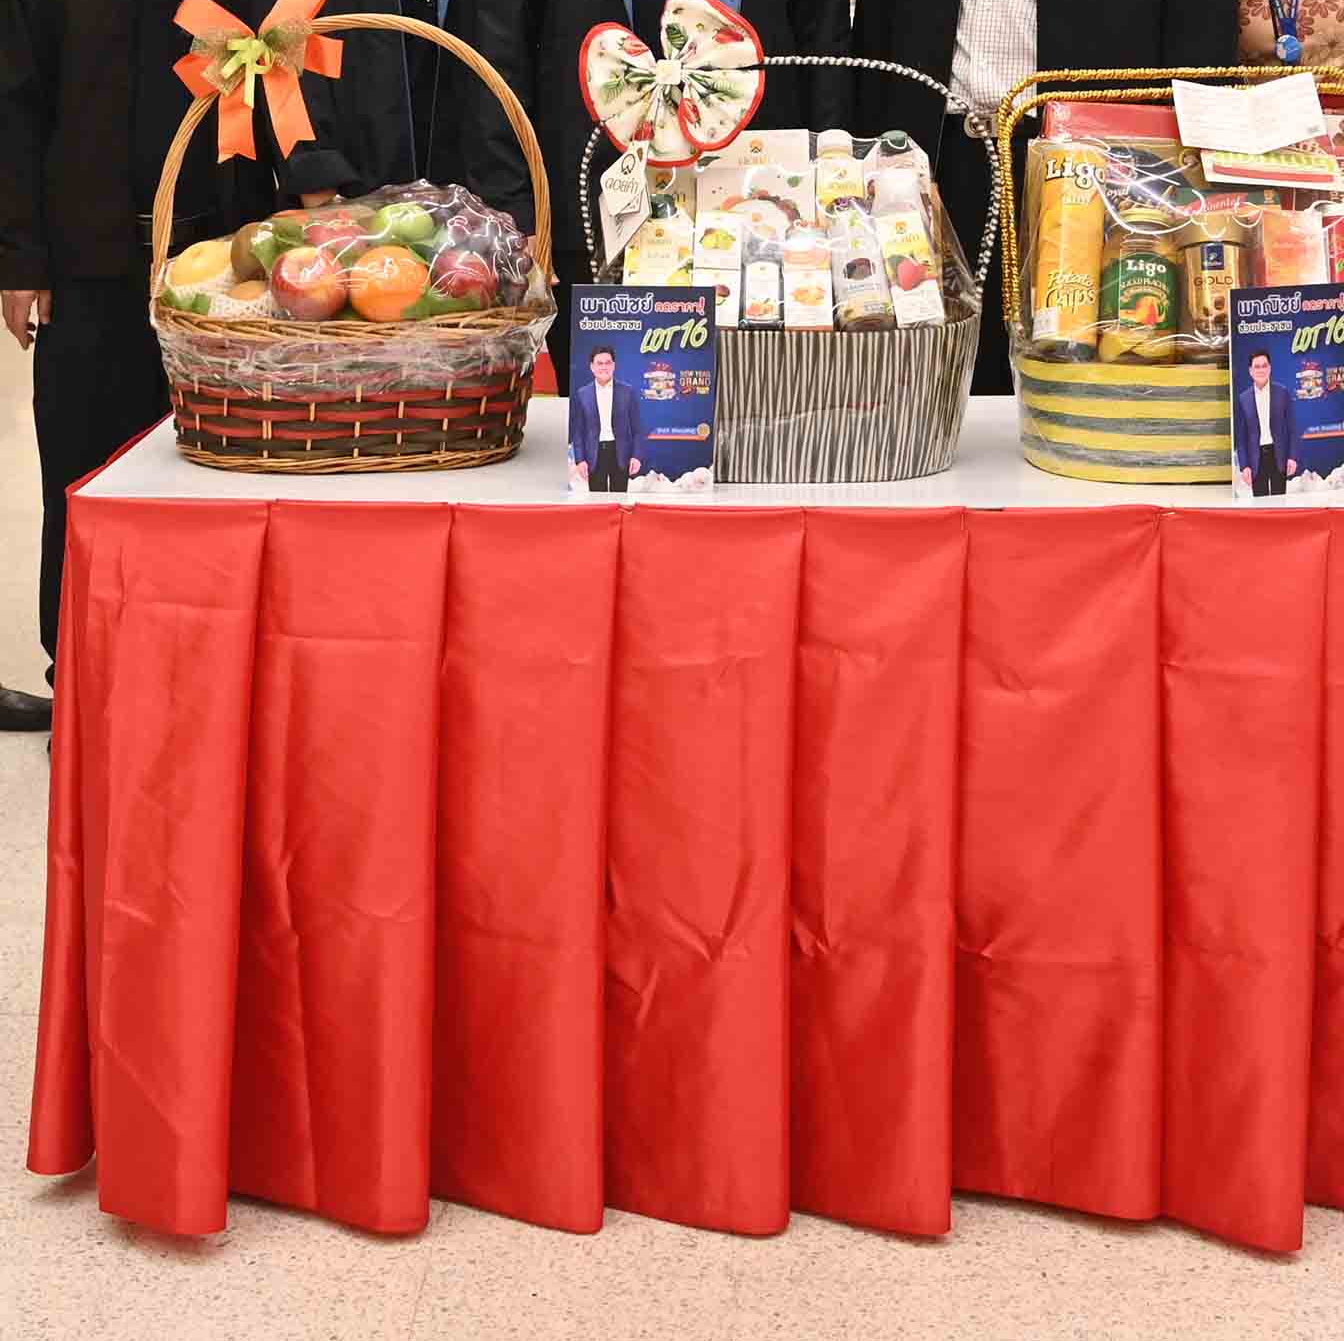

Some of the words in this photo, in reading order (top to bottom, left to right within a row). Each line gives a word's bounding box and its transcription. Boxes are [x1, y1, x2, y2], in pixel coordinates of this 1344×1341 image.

[1045, 158, 1105, 190] Ligo
[1126, 259, 1167, 277] Ligo
[1193, 275, 1234, 286] GOLD
[580, 293, 654, 314] พาณิชย์
[1238, 292, 1302, 317] พาณิชย์
[580, 317, 642, 331] ช่วยประชาชน
[640, 325, 680, 354] LOT
[680, 318, 708, 348] 16
[1292, 323, 1326, 354] LOT
